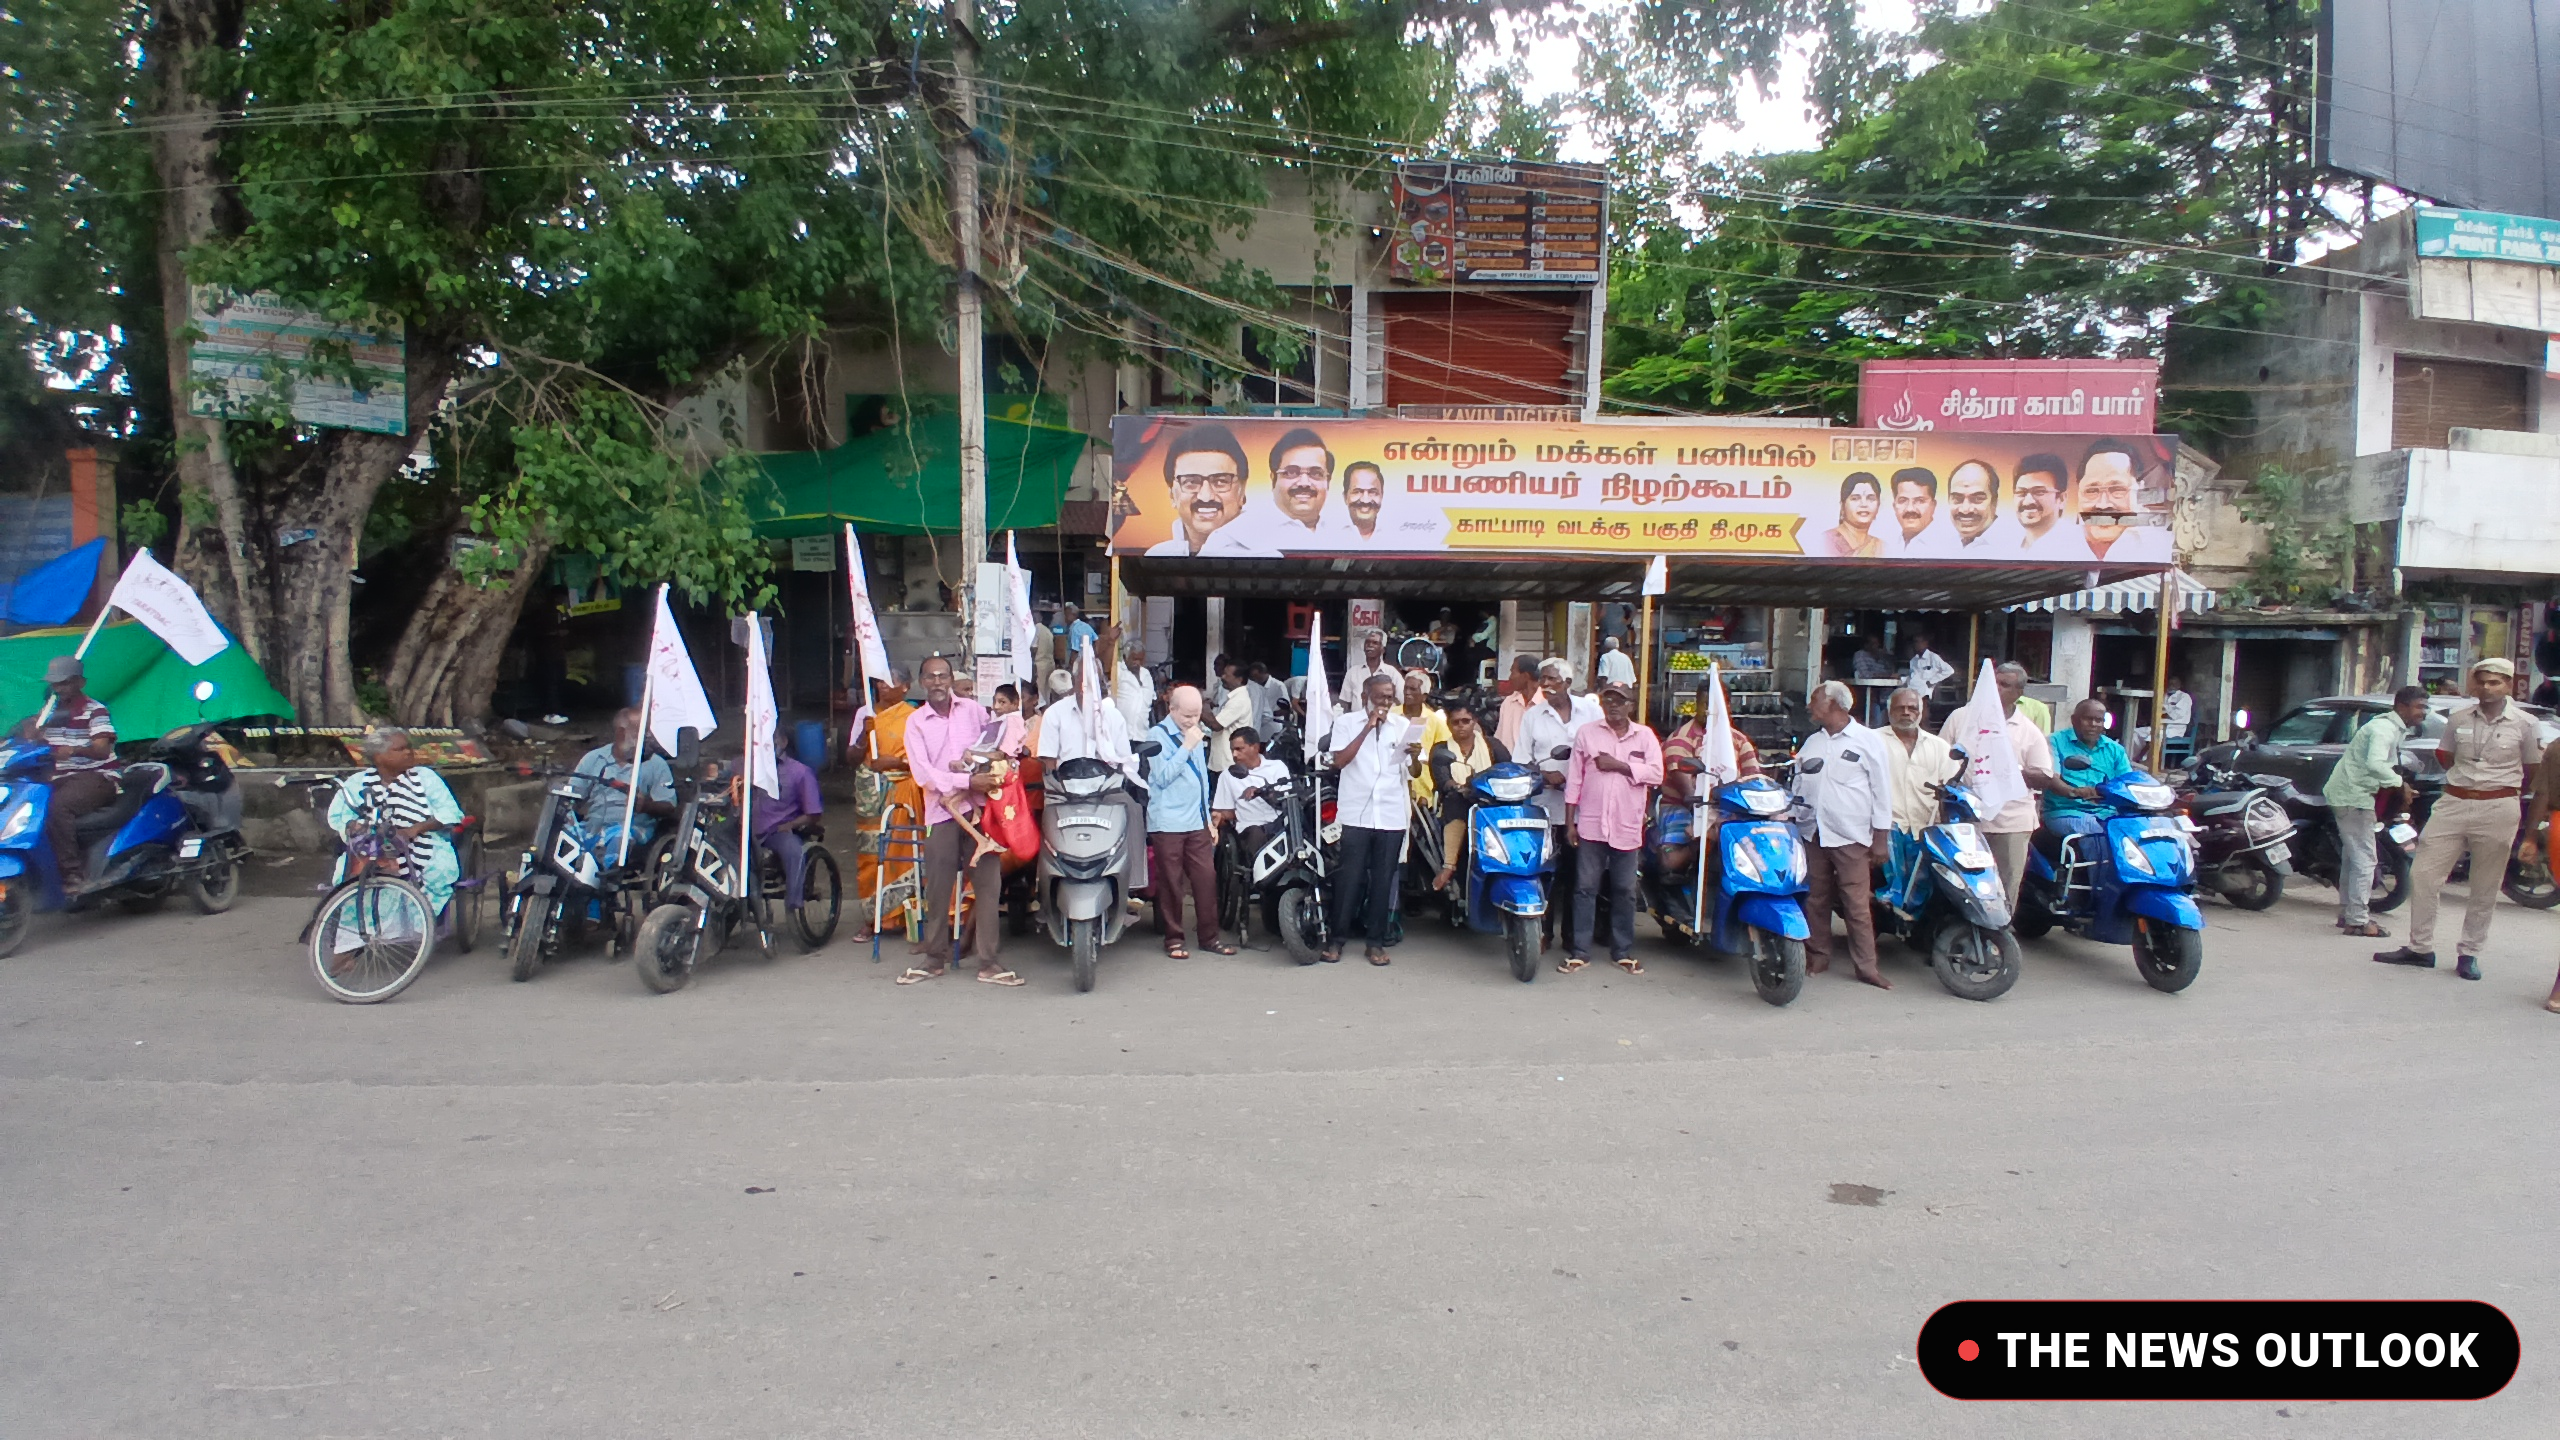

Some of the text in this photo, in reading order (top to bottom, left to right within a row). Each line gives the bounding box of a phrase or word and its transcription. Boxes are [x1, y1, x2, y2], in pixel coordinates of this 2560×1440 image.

[1442, 407, 1573, 422] KAVIN DIGITAL
[1941, 387, 2144, 421] சித்ரா காபி பார்
[1384, 436, 1516, 469] என்றும்
[1536, 439, 1658, 466] மக்கள்
[1406, 470, 1792, 506] பயணியர் நிழற்கூடம்
[1456, 517, 1545, 538] காட்பாடி
[1557, 517, 1631, 540] வடக்கு
[1643, 519, 1699, 541] பகுதி
[1709, 519, 1782, 542] தி.மு.க
